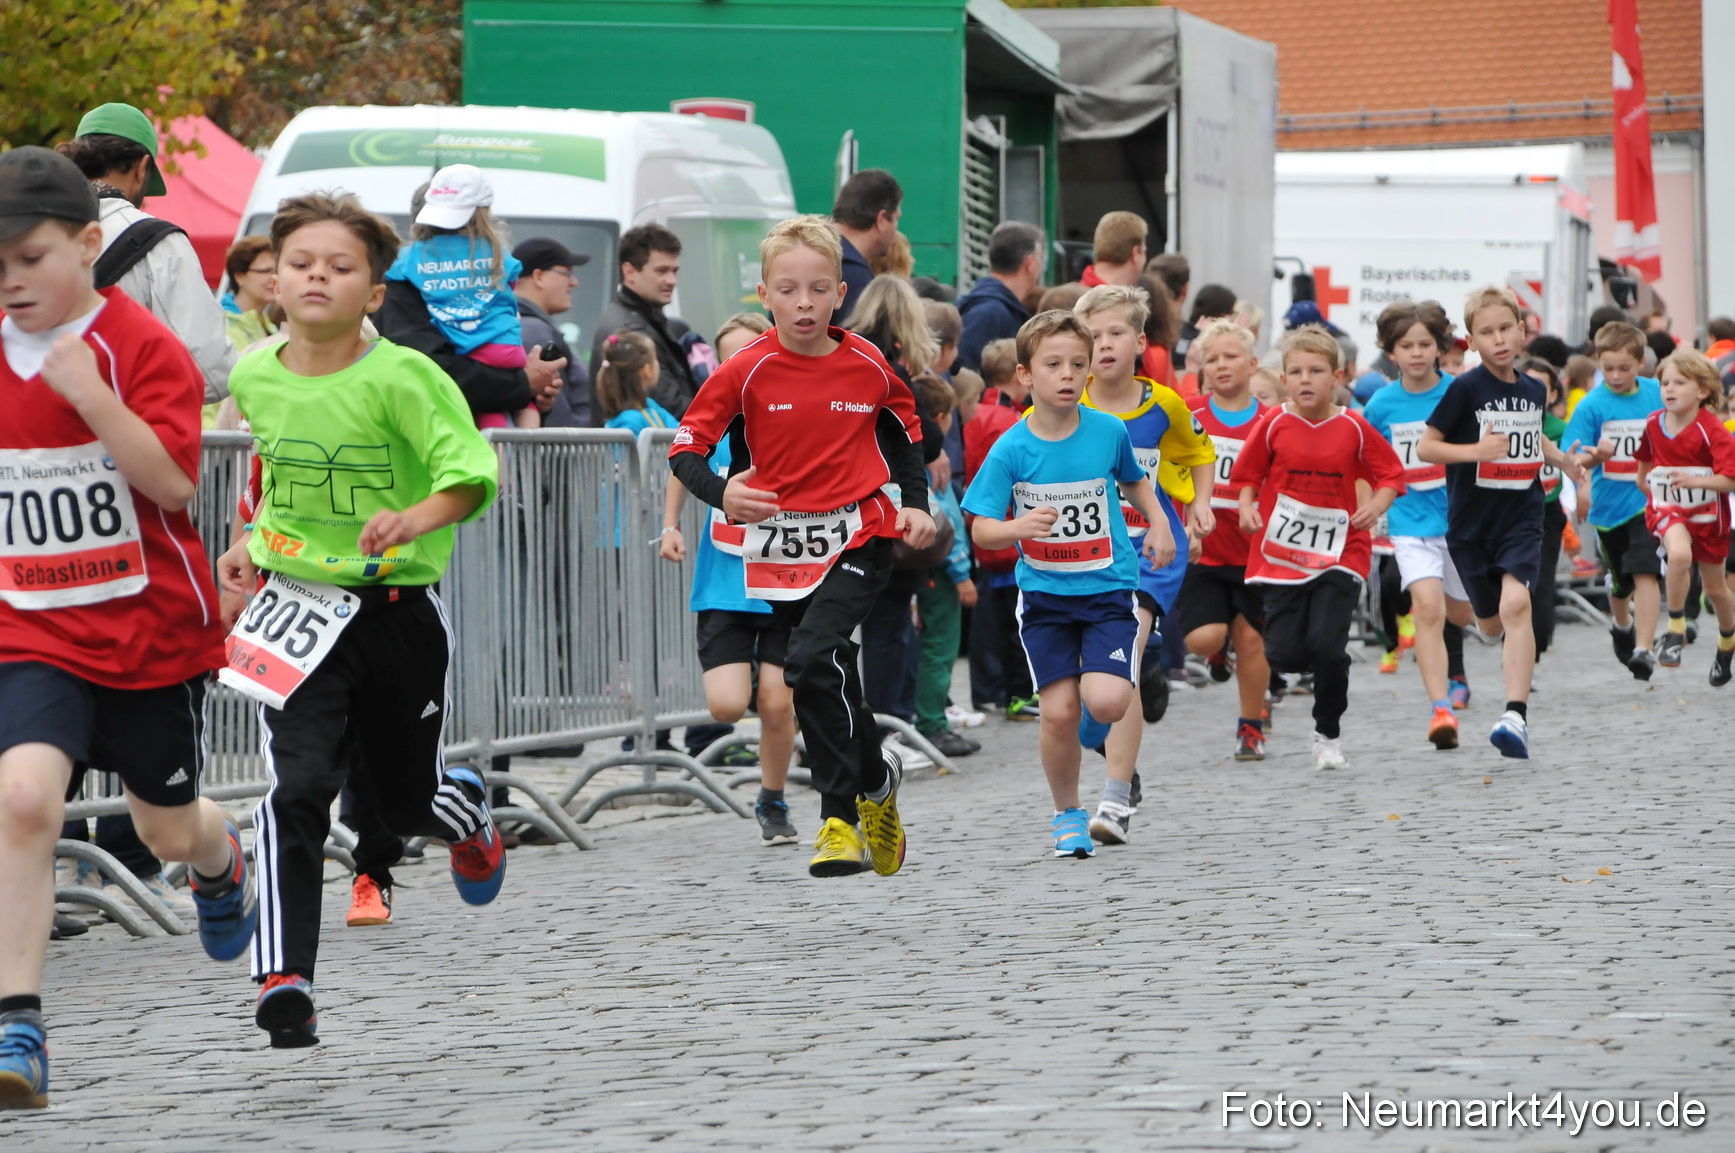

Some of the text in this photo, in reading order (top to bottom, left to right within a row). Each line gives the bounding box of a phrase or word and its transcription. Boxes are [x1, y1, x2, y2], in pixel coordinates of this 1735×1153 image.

[417, 258, 504, 274] NEUMARKTE
[1361, 266, 1471, 283] Bayerisches
[423, 277, 493, 291] STADTLAU
[830, 400, 843, 412] FC
[22, 460, 96, 480] Neumarkt
[1045, 490, 1092, 502] Neumarkt
[0, 481, 122, 546] 7008
[758, 520, 848, 559] 7551
[1276, 514, 1337, 551] 7211
[1045, 547, 1080, 559] Louis
[14, 559, 113, 585] Sebastian
[850, 566, 865, 576] JAKO
[273, 572, 332, 608] Neumarkt
